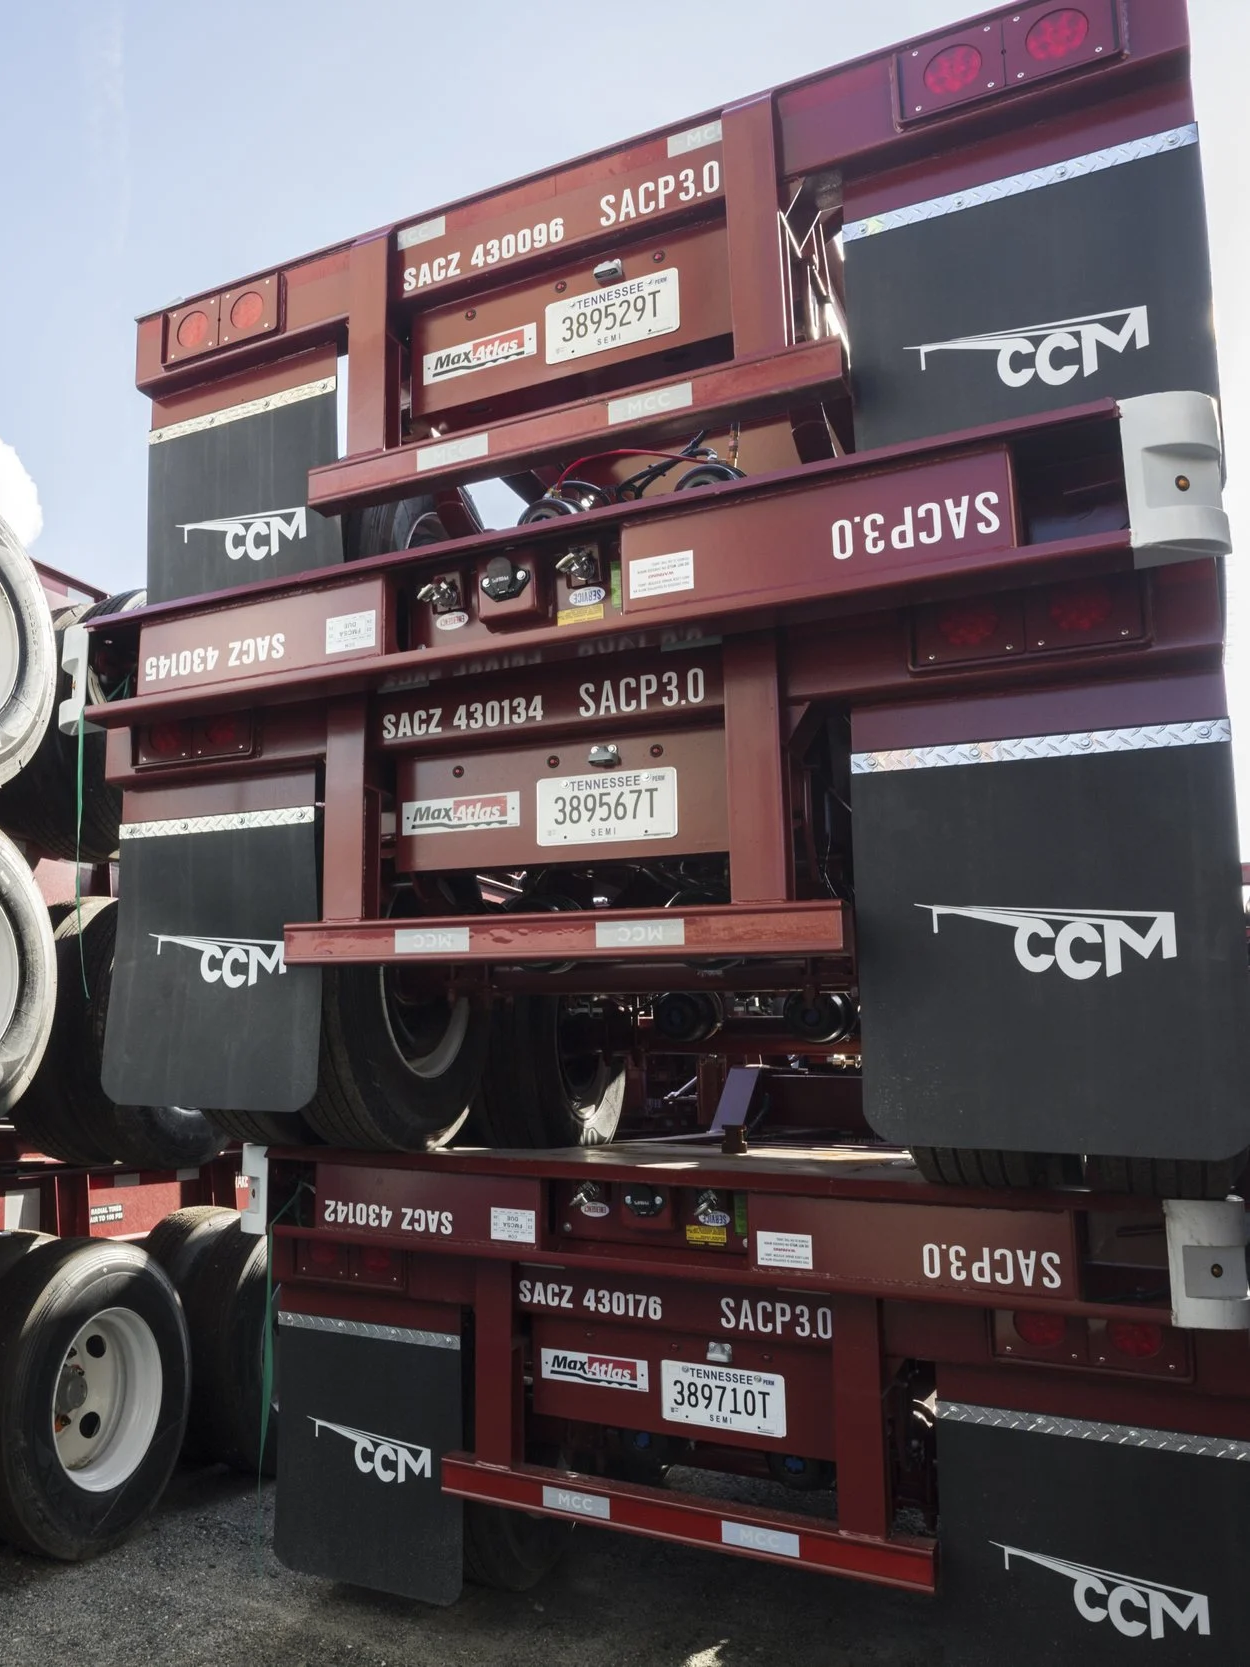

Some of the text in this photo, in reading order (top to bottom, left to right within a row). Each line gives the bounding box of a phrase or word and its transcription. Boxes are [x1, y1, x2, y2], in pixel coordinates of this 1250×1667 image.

[599, 160, 720, 226] SACP3.0
[403, 218, 564, 292] SACZ 430096
[577, 282, 644, 310] TENNESSEE
[562, 290, 661, 343] 389529T
[434, 336, 519, 370] MaxAtlas
[597, 333, 622, 346] SEMI
[997, 305, 1150, 388] CCM
[627, 391, 671, 415] MCC
[225, 506, 307, 561] CCM
[831, 492, 1002, 560] SACP3.0
[573, 590, 602, 603] SERVICE
[145, 633, 286, 682] SACZ 430145
[579, 667, 705, 717] SACP3.0
[382, 695, 543, 739] SACZ 430134
[570, 774, 666, 792] TENNESSEE PERM
[413, 798, 502, 823] MaxAtlas
[554, 788, 658, 825] 389567T
[591, 827, 617, 837] SEMI
[1013, 912, 1177, 981] CCM
[91, 1207, 108, 1215] RADIAL
[324, 1200, 453, 1235] SACZ 430142
[922, 1243, 1062, 1289] SACP3.0
[518, 1280, 662, 1321] SACZ 430176
[720, 1298, 832, 1340] SACP3.0
[550, 1354, 632, 1381] MaxAtlas
[689, 1367, 775, 1387] TENNESSEE PERM
[673, 1379, 771, 1419] 389710T
[709, 1414, 732, 1425] SEMI
[353, 1436, 432, 1486] CCM
[557, 1493, 593, 1511] MCC
[1073, 1578, 1211, 1639] CCM
